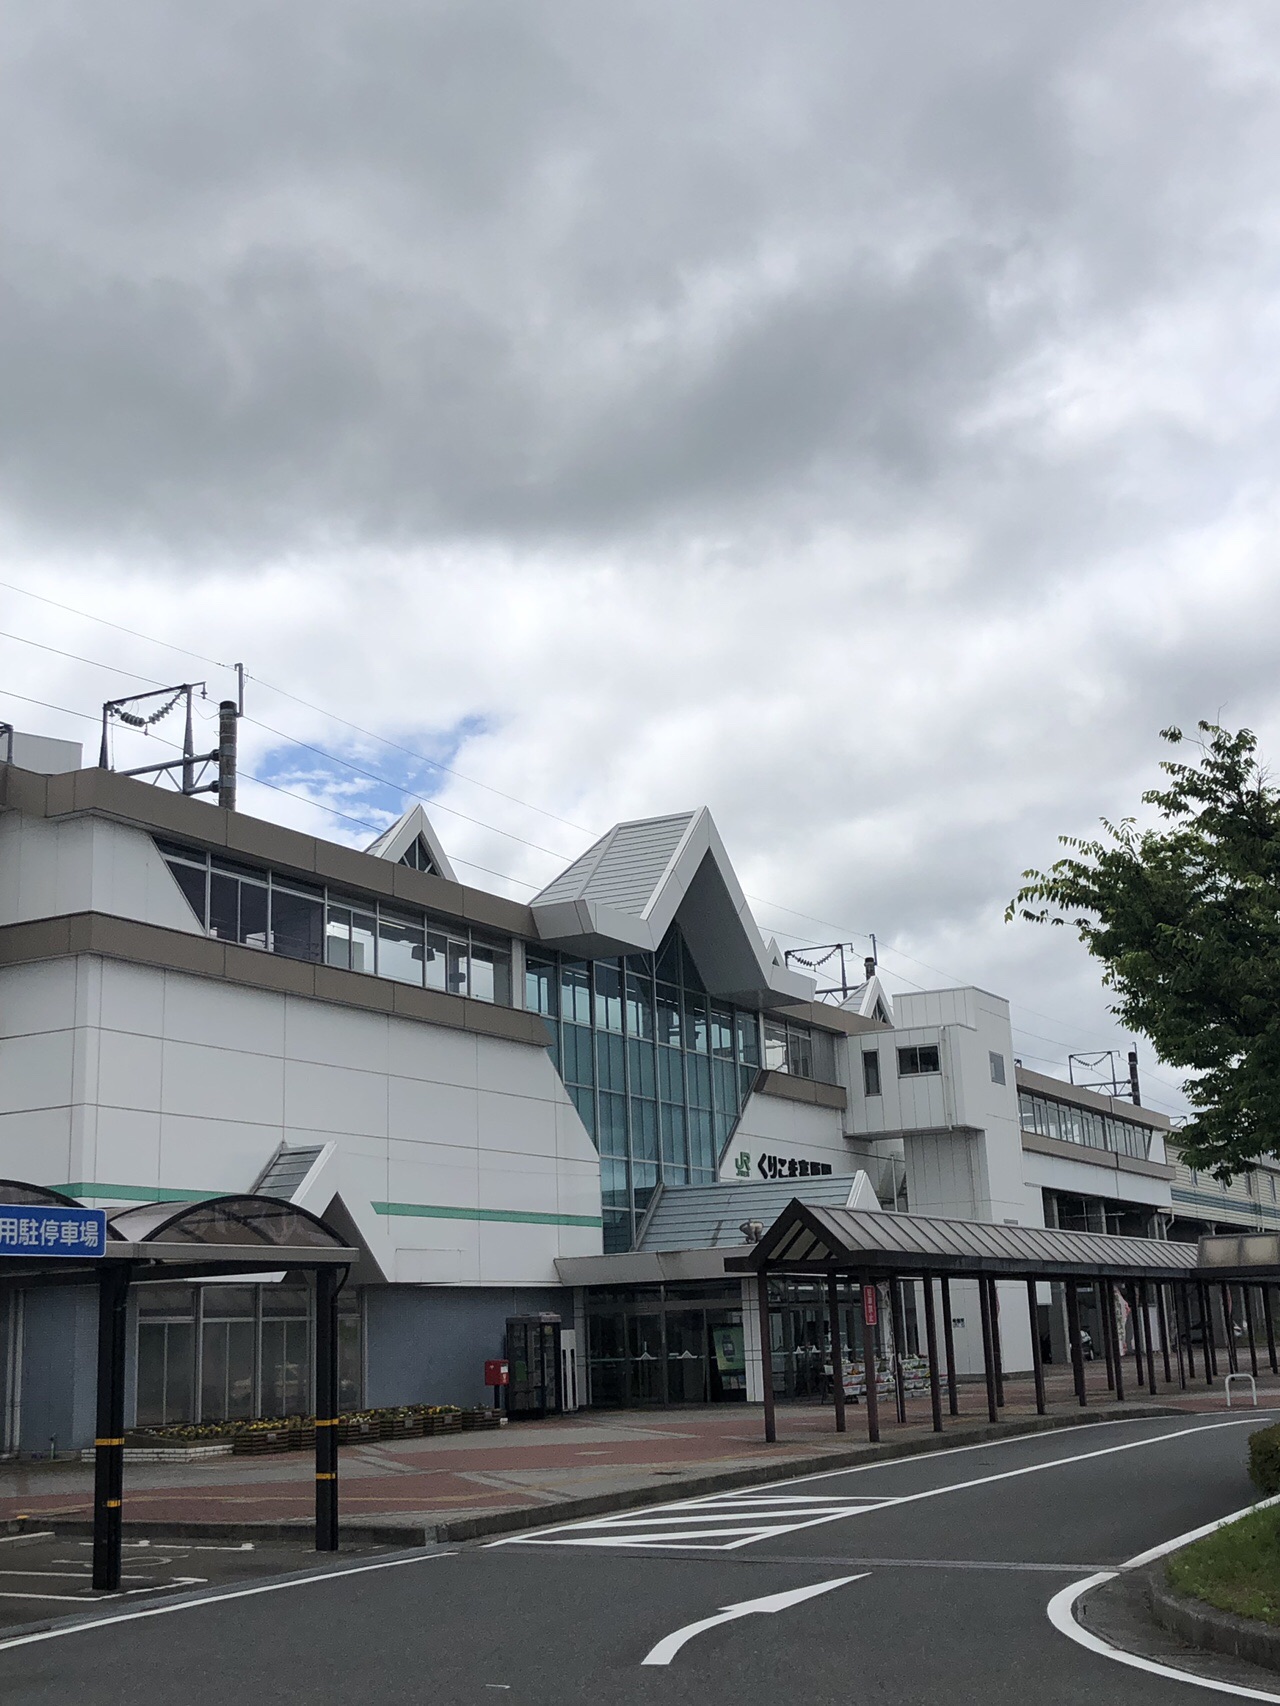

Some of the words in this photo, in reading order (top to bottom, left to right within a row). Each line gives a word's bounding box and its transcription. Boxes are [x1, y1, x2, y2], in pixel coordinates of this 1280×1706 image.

[735, 1151, 751, 1171] JR
[0, 1218, 99, 1247] 用駐停車場
